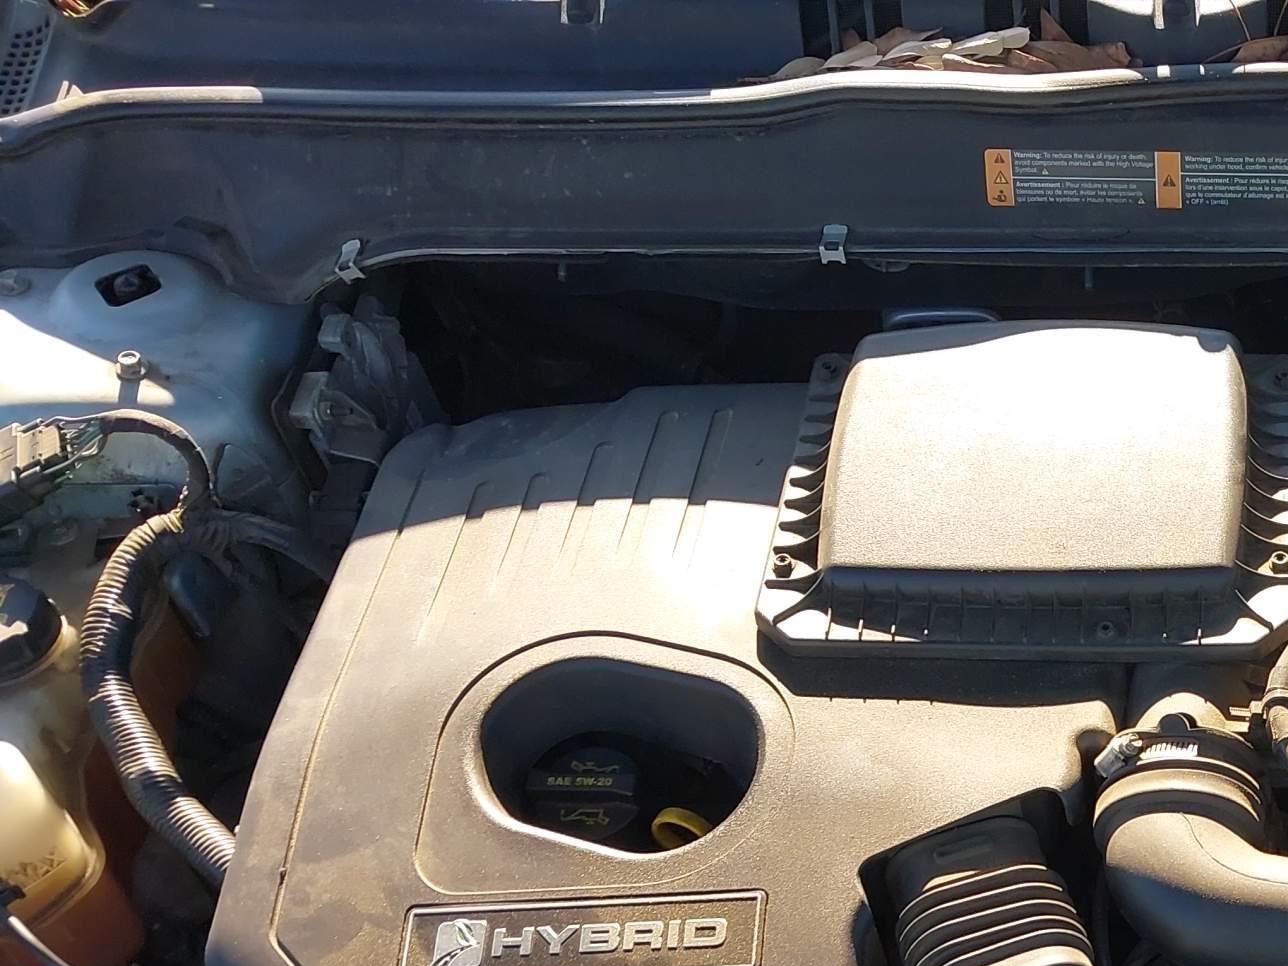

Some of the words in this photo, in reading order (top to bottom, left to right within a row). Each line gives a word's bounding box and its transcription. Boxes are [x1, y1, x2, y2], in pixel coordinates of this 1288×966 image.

[546, 775, 573, 787] SAE
[574, 775, 614, 787] 5W-20
[490, 916, 730, 959] HYBRID
